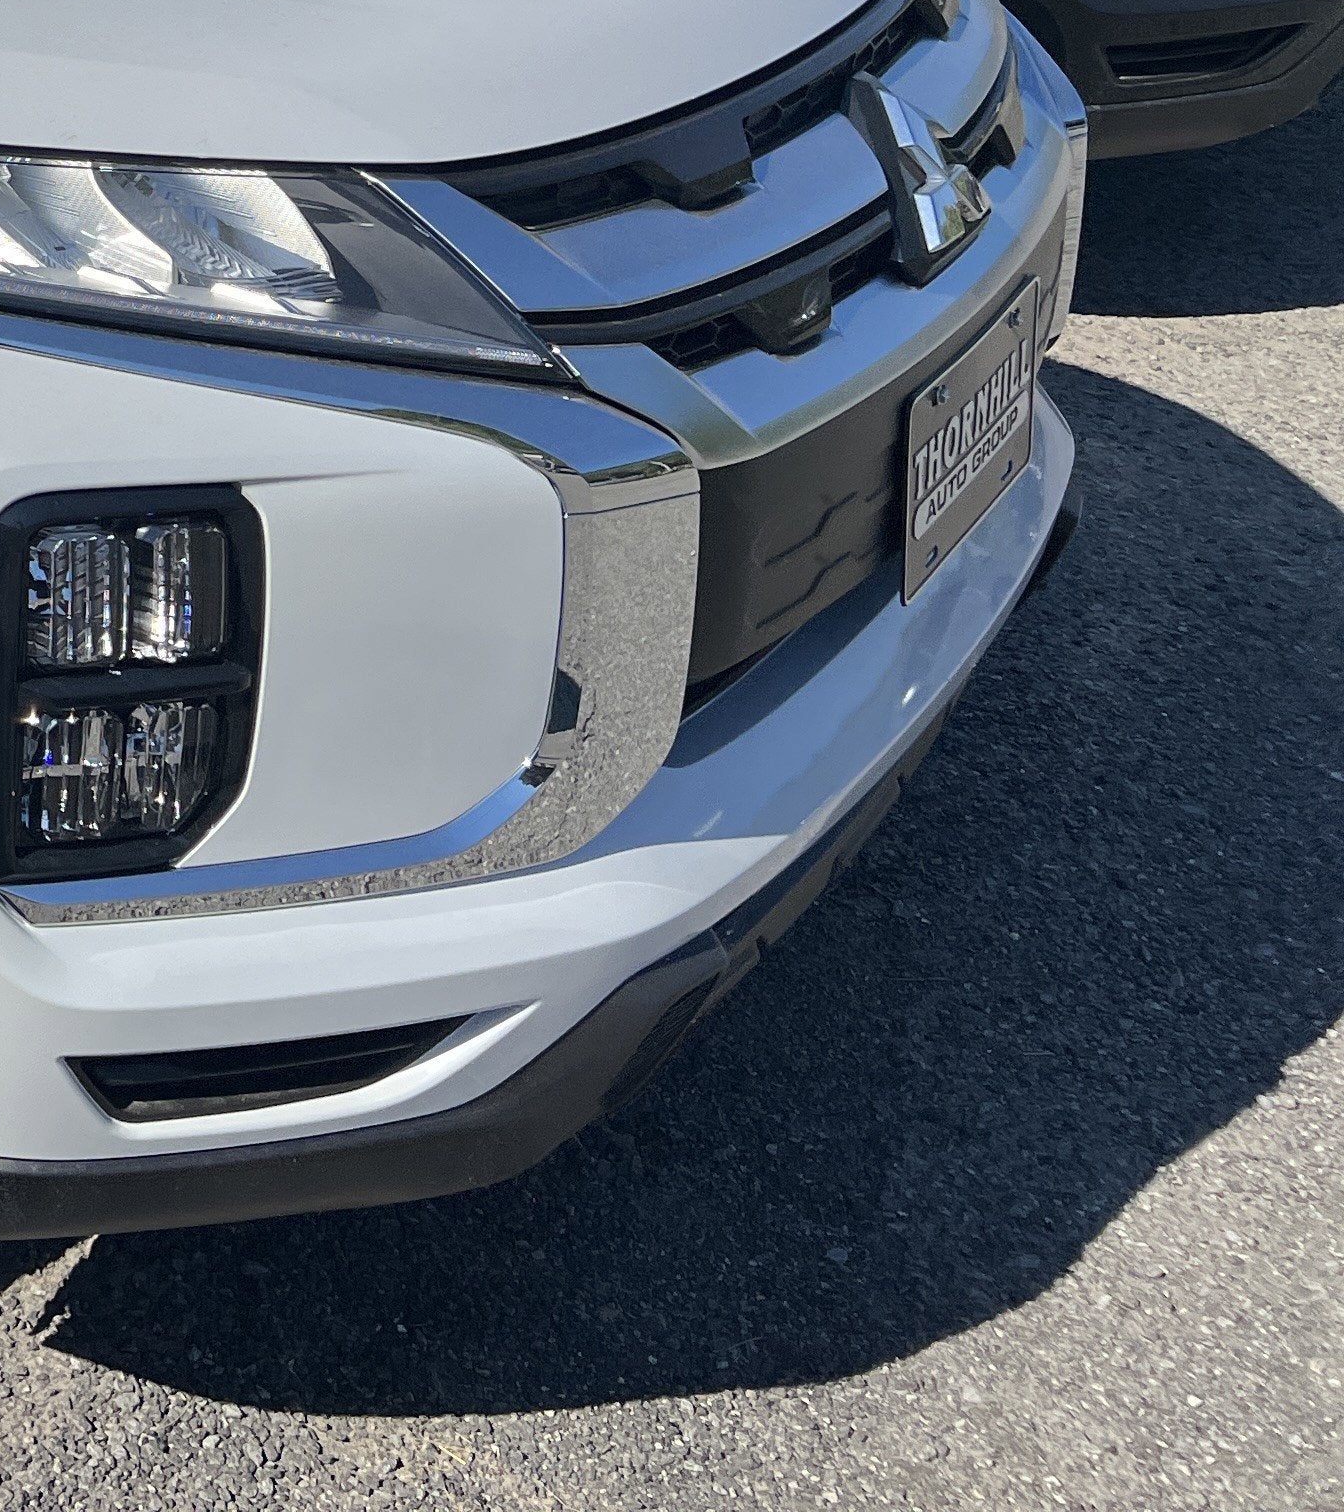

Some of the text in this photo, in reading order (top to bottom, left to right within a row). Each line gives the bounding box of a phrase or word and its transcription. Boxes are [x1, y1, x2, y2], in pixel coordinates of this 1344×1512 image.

[913, 338, 1032, 501] THORNHILL
[926, 405, 1019, 525] AUTO GROUP
